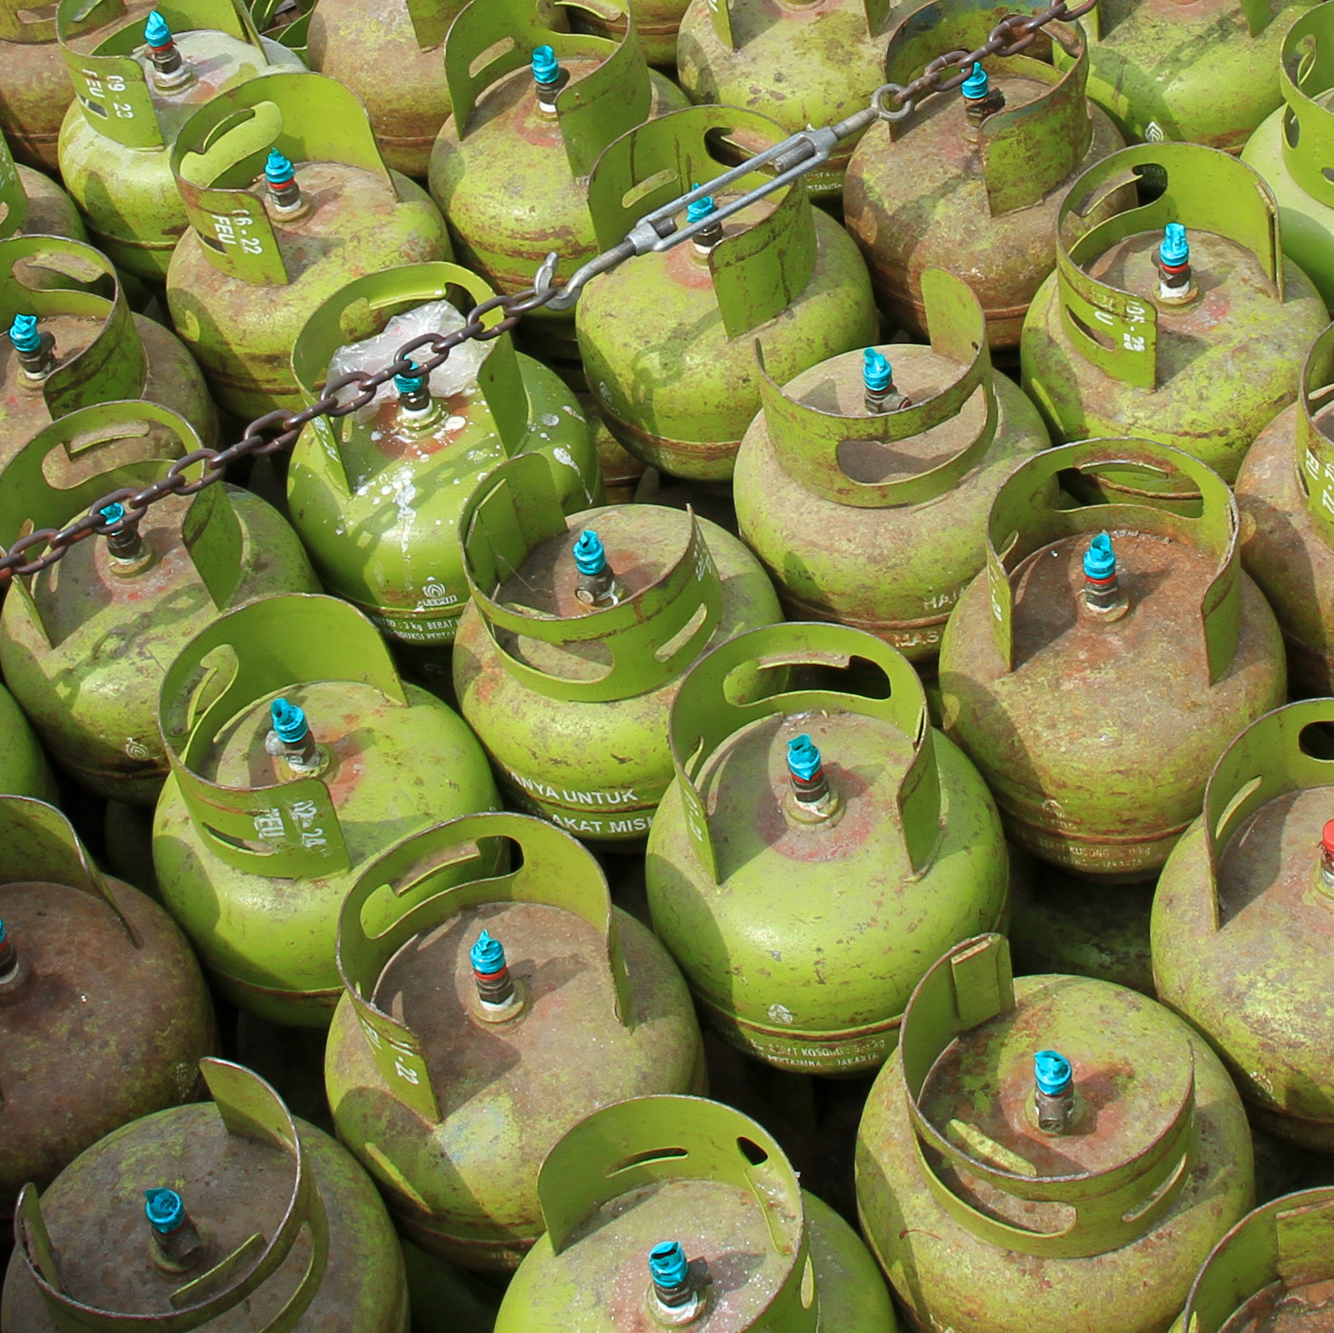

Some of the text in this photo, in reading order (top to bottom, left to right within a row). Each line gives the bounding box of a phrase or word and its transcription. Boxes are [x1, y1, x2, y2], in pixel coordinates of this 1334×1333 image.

[81, 68, 105, 98] FEU
[211, 214, 237, 245] FEU
[563, 787, 638, 805] UNTUK
